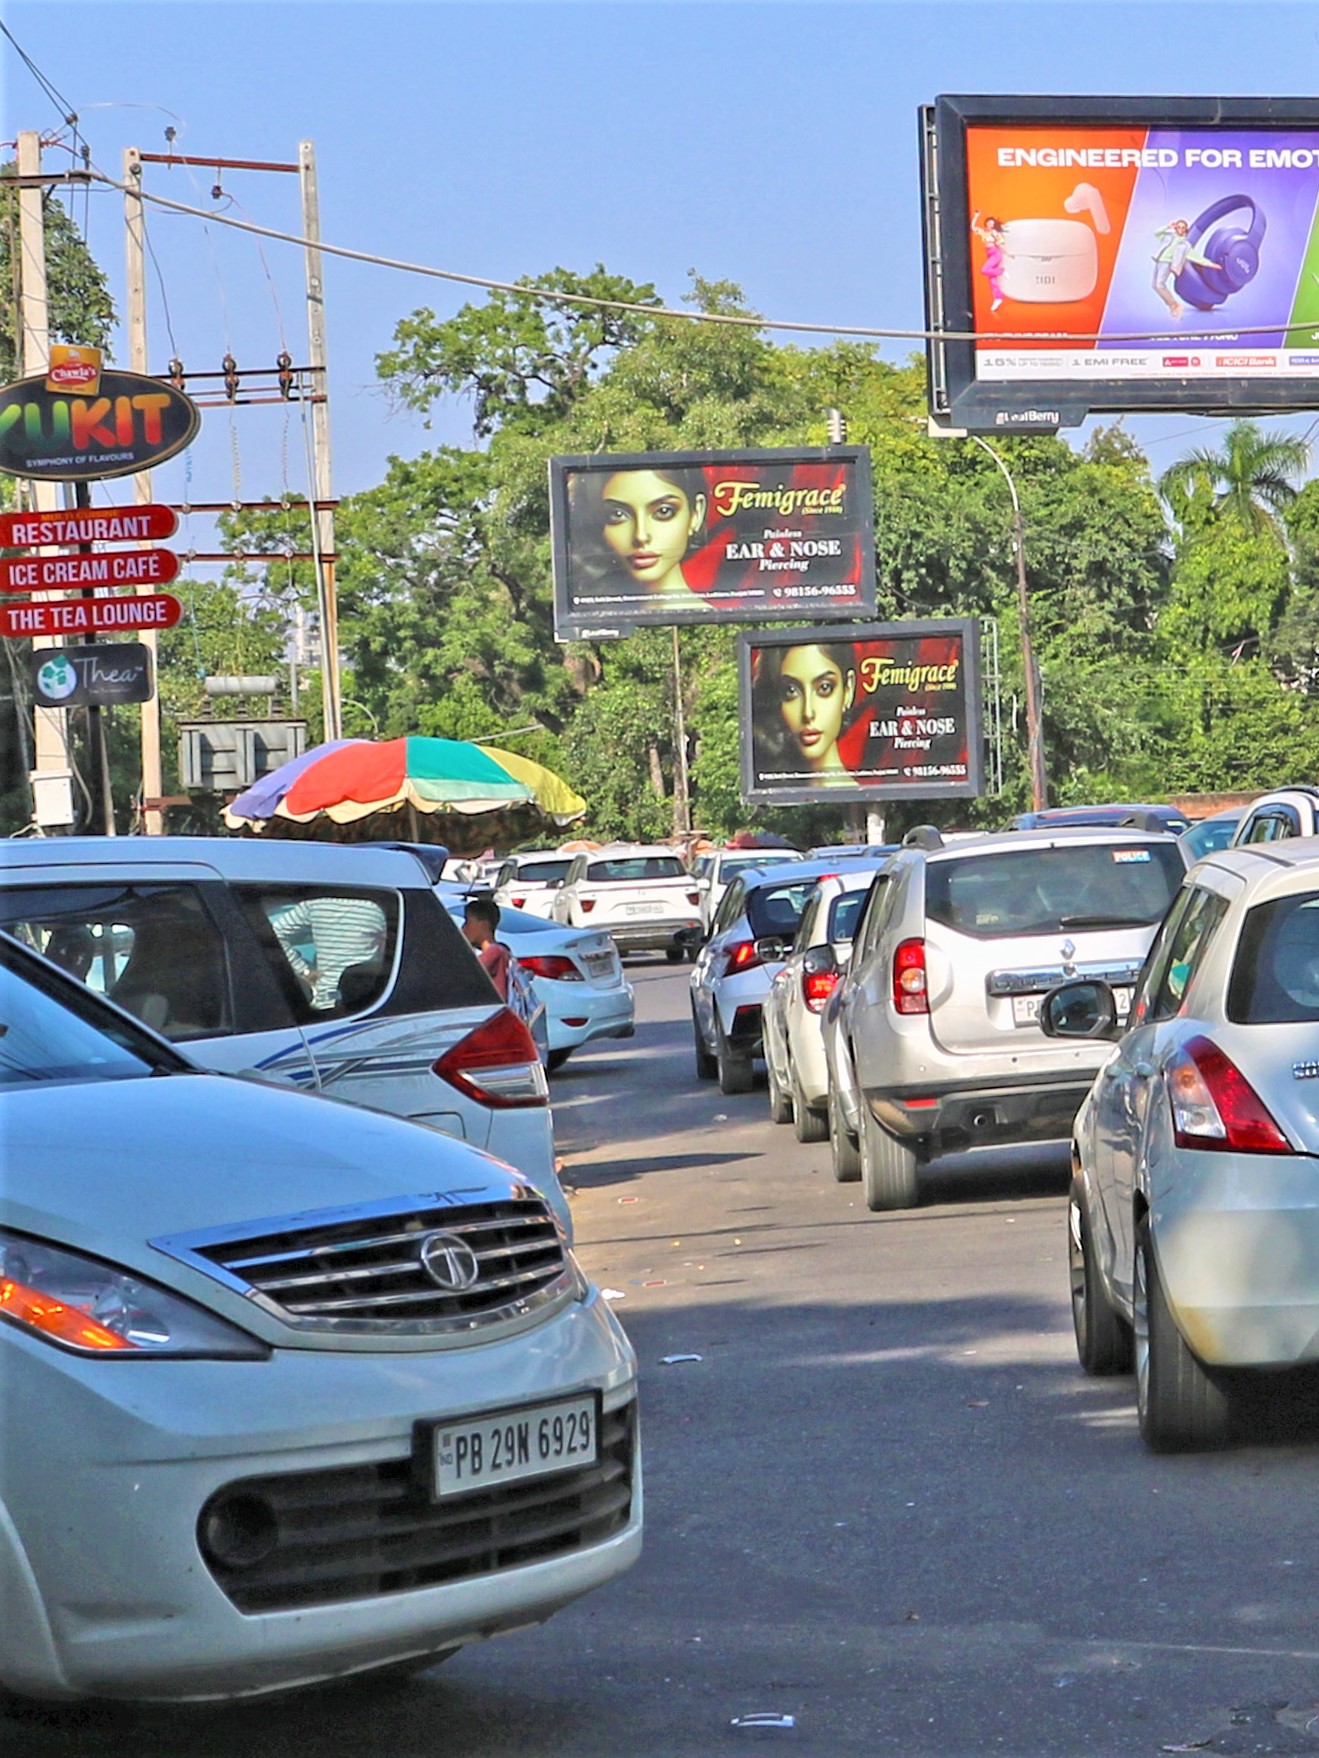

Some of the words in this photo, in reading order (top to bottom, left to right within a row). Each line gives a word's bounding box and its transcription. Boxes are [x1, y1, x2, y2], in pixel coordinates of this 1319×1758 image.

[997, 147, 1179, 168] ENGINEERED
[1185, 148, 1243, 168] FOR
[26, 456, 73, 468] SYMPHONY
[75, 455, 86, 464] OF
[88, 451, 135, 463] FLAVOURS
[714, 481, 844, 517] Femigrace
[12, 515, 151, 544] RESTAURANT
[726, 542, 766, 560] EAR
[769, 541, 786, 558] &
[790, 539, 842, 557] NOSE
[9, 563, 38, 586] ICE
[43, 558, 109, 583] CREAM
[113, 552, 160, 581] CAFÉ
[758, 558, 810, 572] Piercing
[7, 608, 45, 630] THE
[50, 604, 88, 627] TEA
[92, 600, 168, 625] LOUNGE
[73, 655, 138, 689] Thea
[860, 657, 957, 693] Femigrace
[869, 720, 898, 738] EAR
[901, 719, 914, 736] &
[916, 717, 956, 735] NOSE
[1113, 851, 1151, 863] POLICE
[455, 1432, 483, 1479] PB
[490, 1421, 530, 1472] 29N
[538, 1410, 590, 1460] 6929
